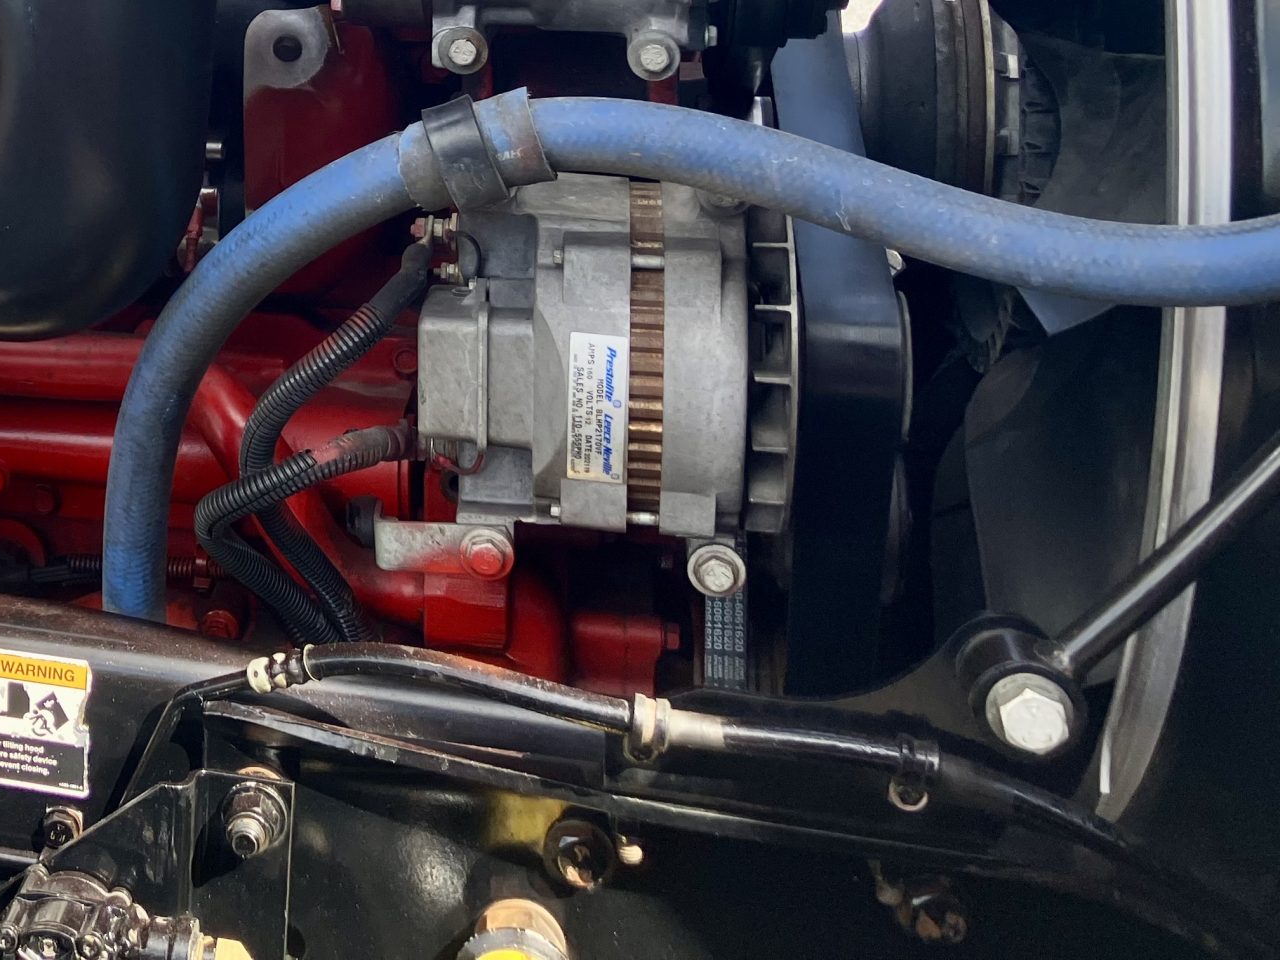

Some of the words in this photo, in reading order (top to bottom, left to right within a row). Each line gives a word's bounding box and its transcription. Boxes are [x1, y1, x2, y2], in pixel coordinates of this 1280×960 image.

[587, 342, 595, 365] AMPS
[576, 367, 585, 393] SALES
[605, 346, 617, 402] Prestolite
[585, 390, 593, 416] VOLTS
[596, 378, 604, 404] MODEL
[584, 435, 593, 453] DATE
[1, 657, 75, 683] WARNING
[2, 739, 24, 752] tilting
[24, 743, 45, 754] hood
[9, 751, 32, 763] safety
[32, 755, 58, 766] device
[21, 763, 50, 776] closing.
